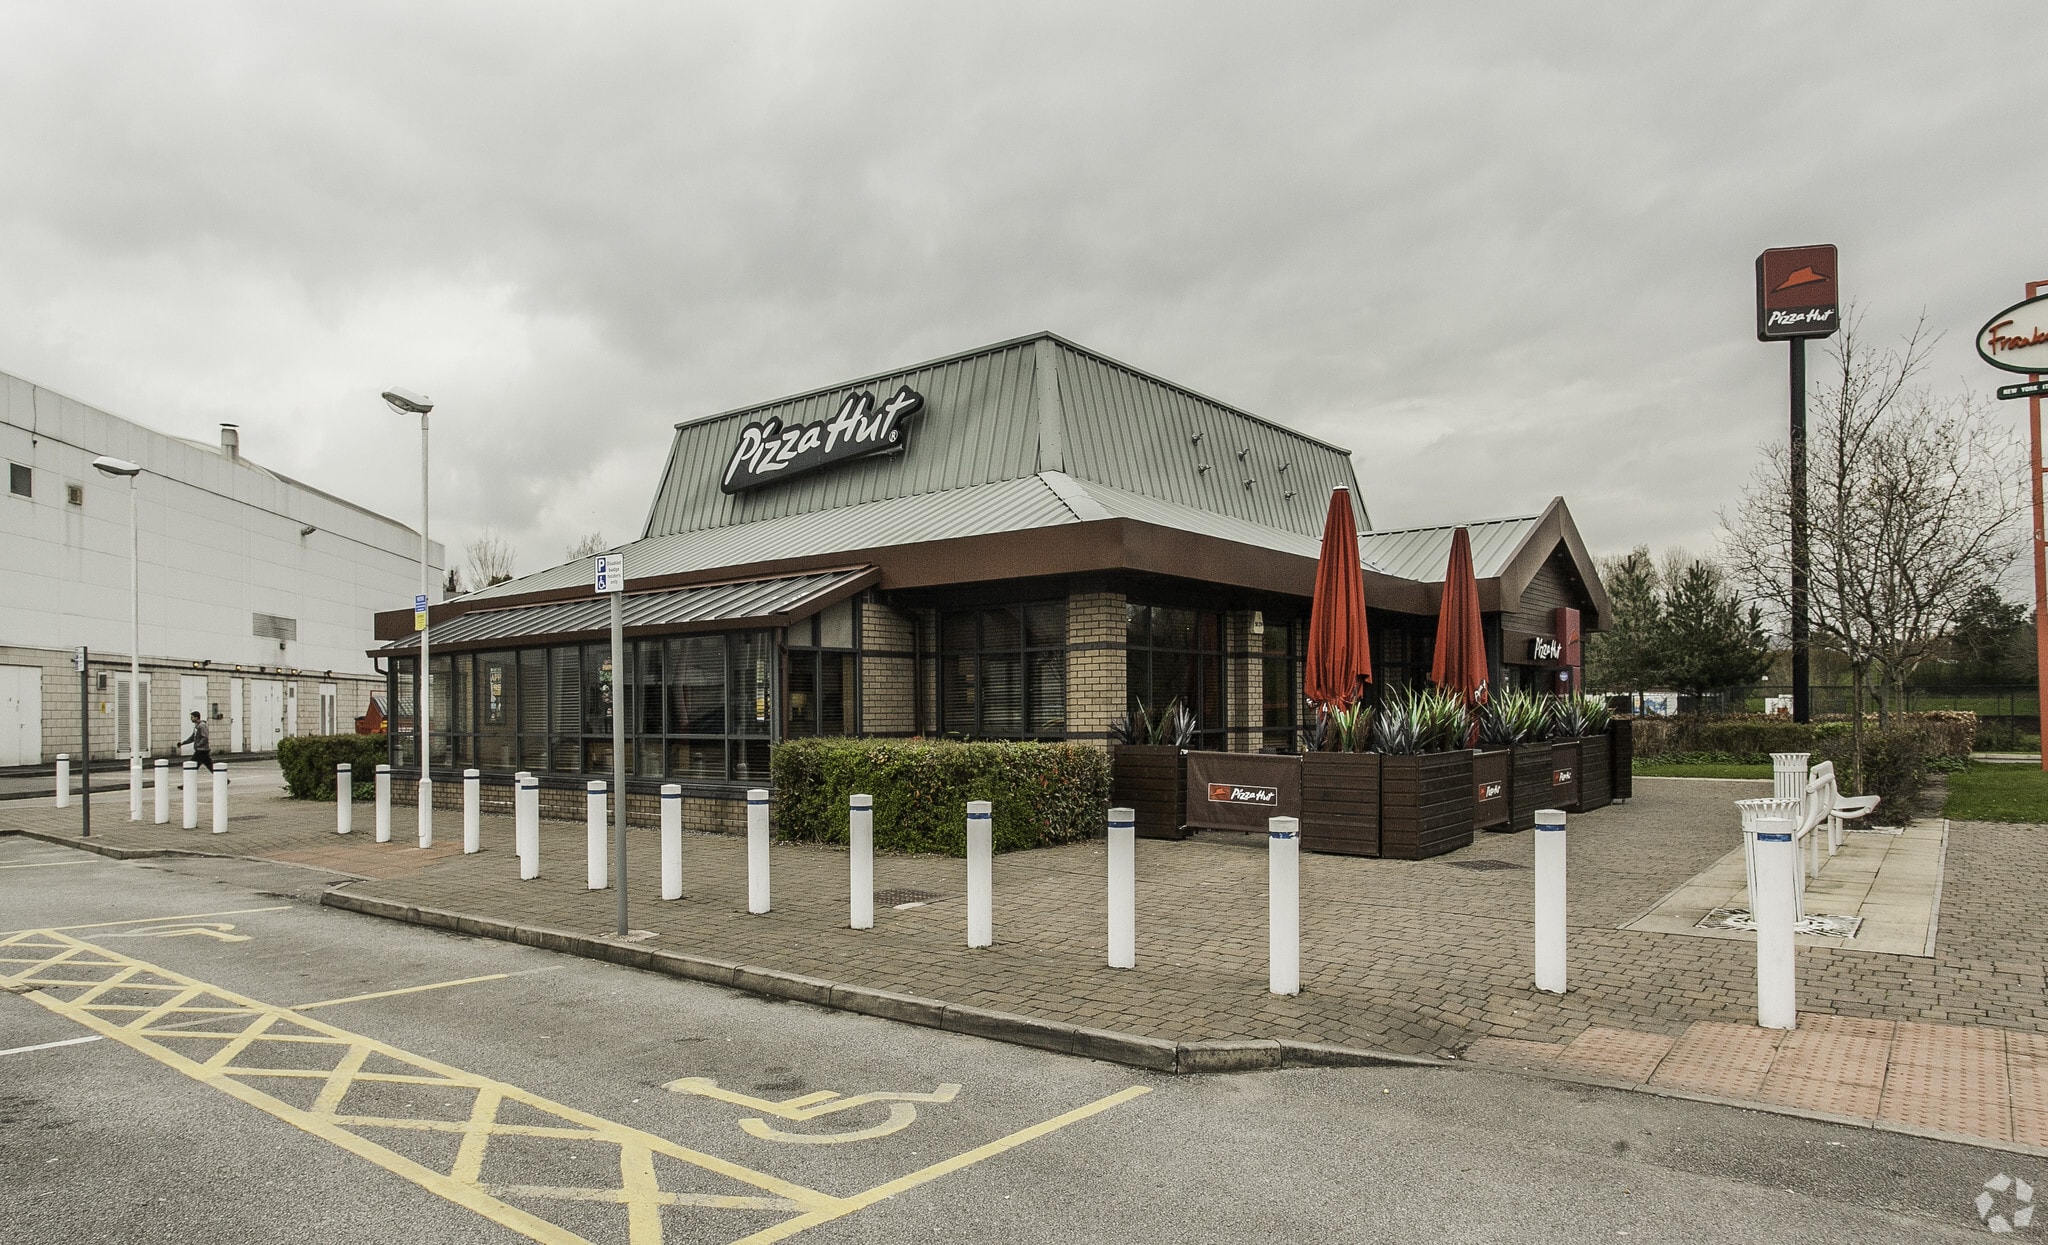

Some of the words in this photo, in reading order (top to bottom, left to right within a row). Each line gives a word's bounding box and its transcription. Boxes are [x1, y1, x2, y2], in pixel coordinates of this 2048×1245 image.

[1768, 311, 1805, 326] Pizza
[1806, 308, 1834, 322] Hut
[725, 422, 821, 485] Pizza
[825, 391, 915, 453] Hut
[1533, 637, 1550, 660] Pizza
[1550, 639, 1562, 659] Hut
[1230, 788, 1255, 801] Pizza
[1255, 790, 1275, 801] Hut
